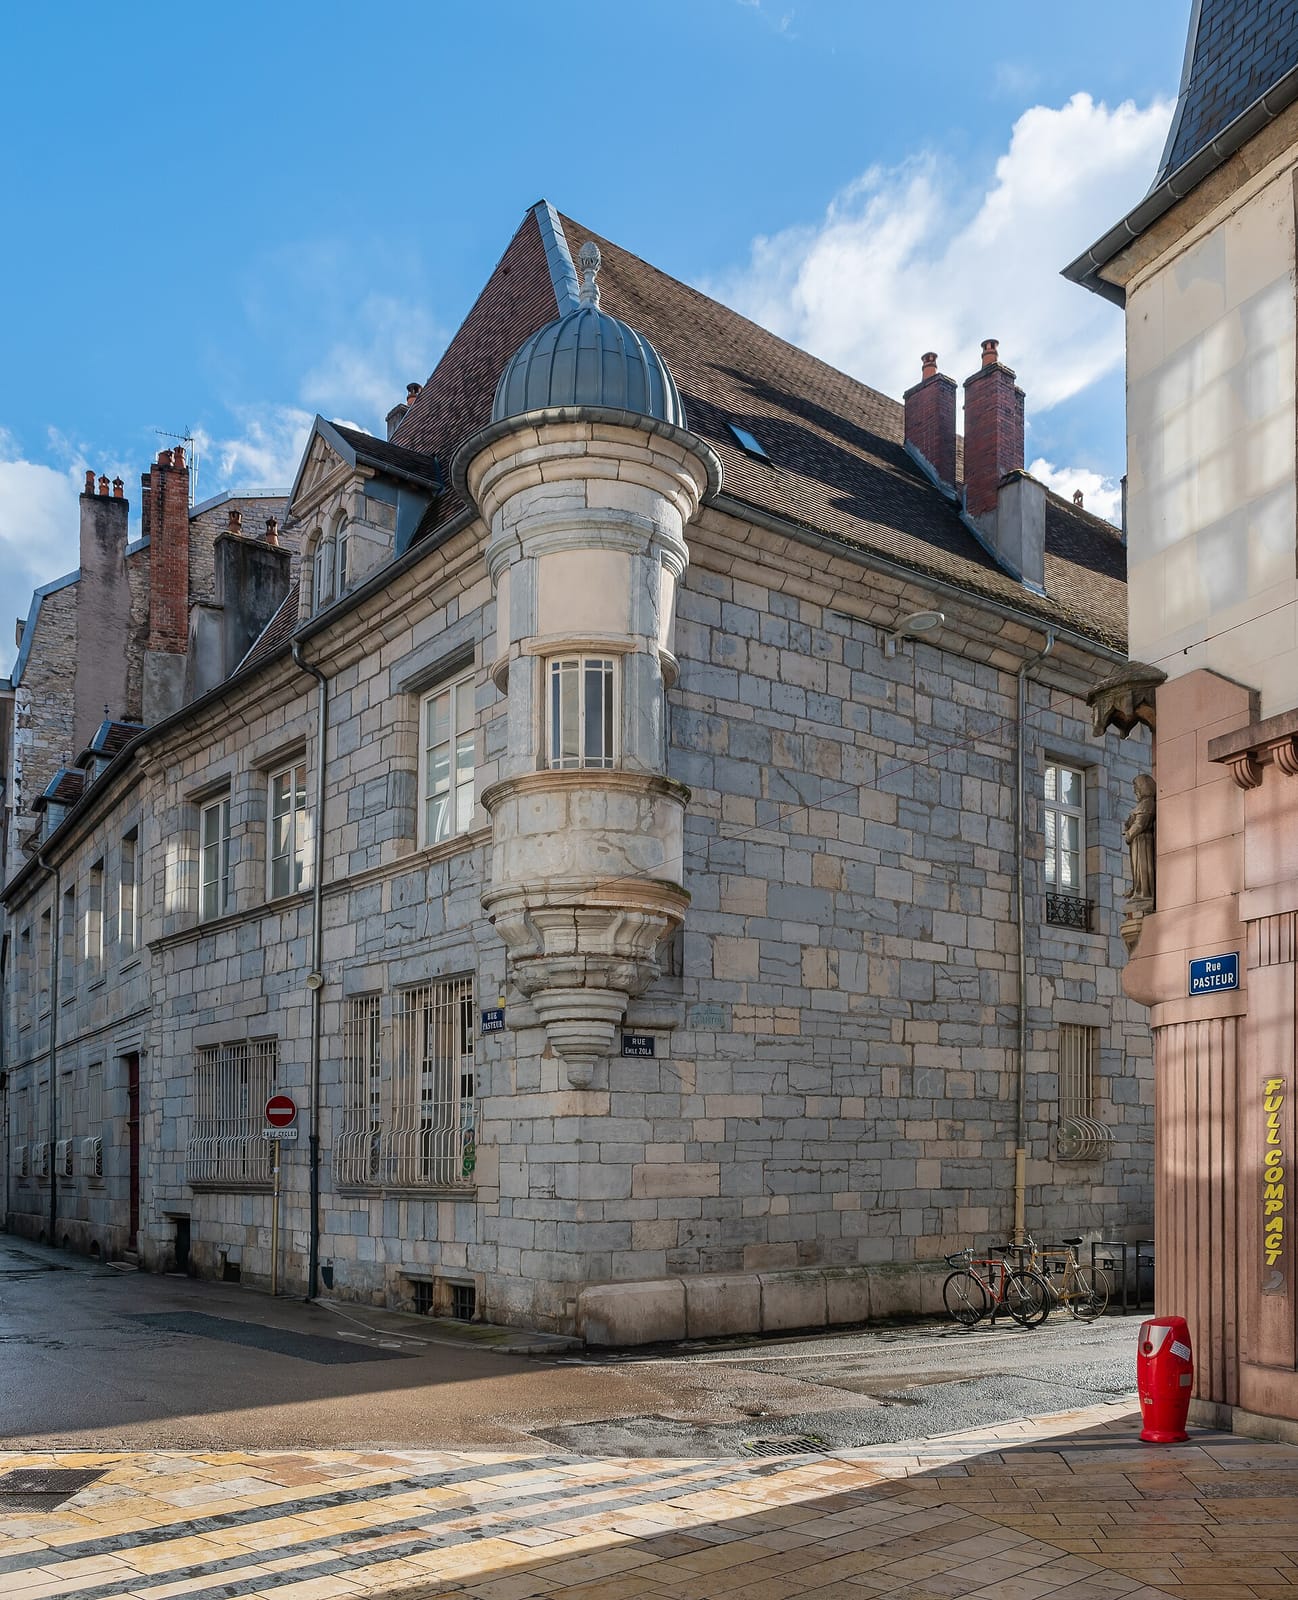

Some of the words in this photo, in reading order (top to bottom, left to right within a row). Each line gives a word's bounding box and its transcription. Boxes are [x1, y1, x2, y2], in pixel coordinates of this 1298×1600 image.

[1205, 962, 1221, 973] Rue
[1193, 972, 1234, 989] PASTEUR
[487, 1011, 498, 1020] RUE
[482, 1020, 502, 1030] PASTEUR
[631, 1038, 646, 1046] RUE
[638, 1047, 652, 1055] ZOLA
[1263, 1079, 1285, 1145] FULL
[1263, 1149, 1285, 1267] COMPACT
